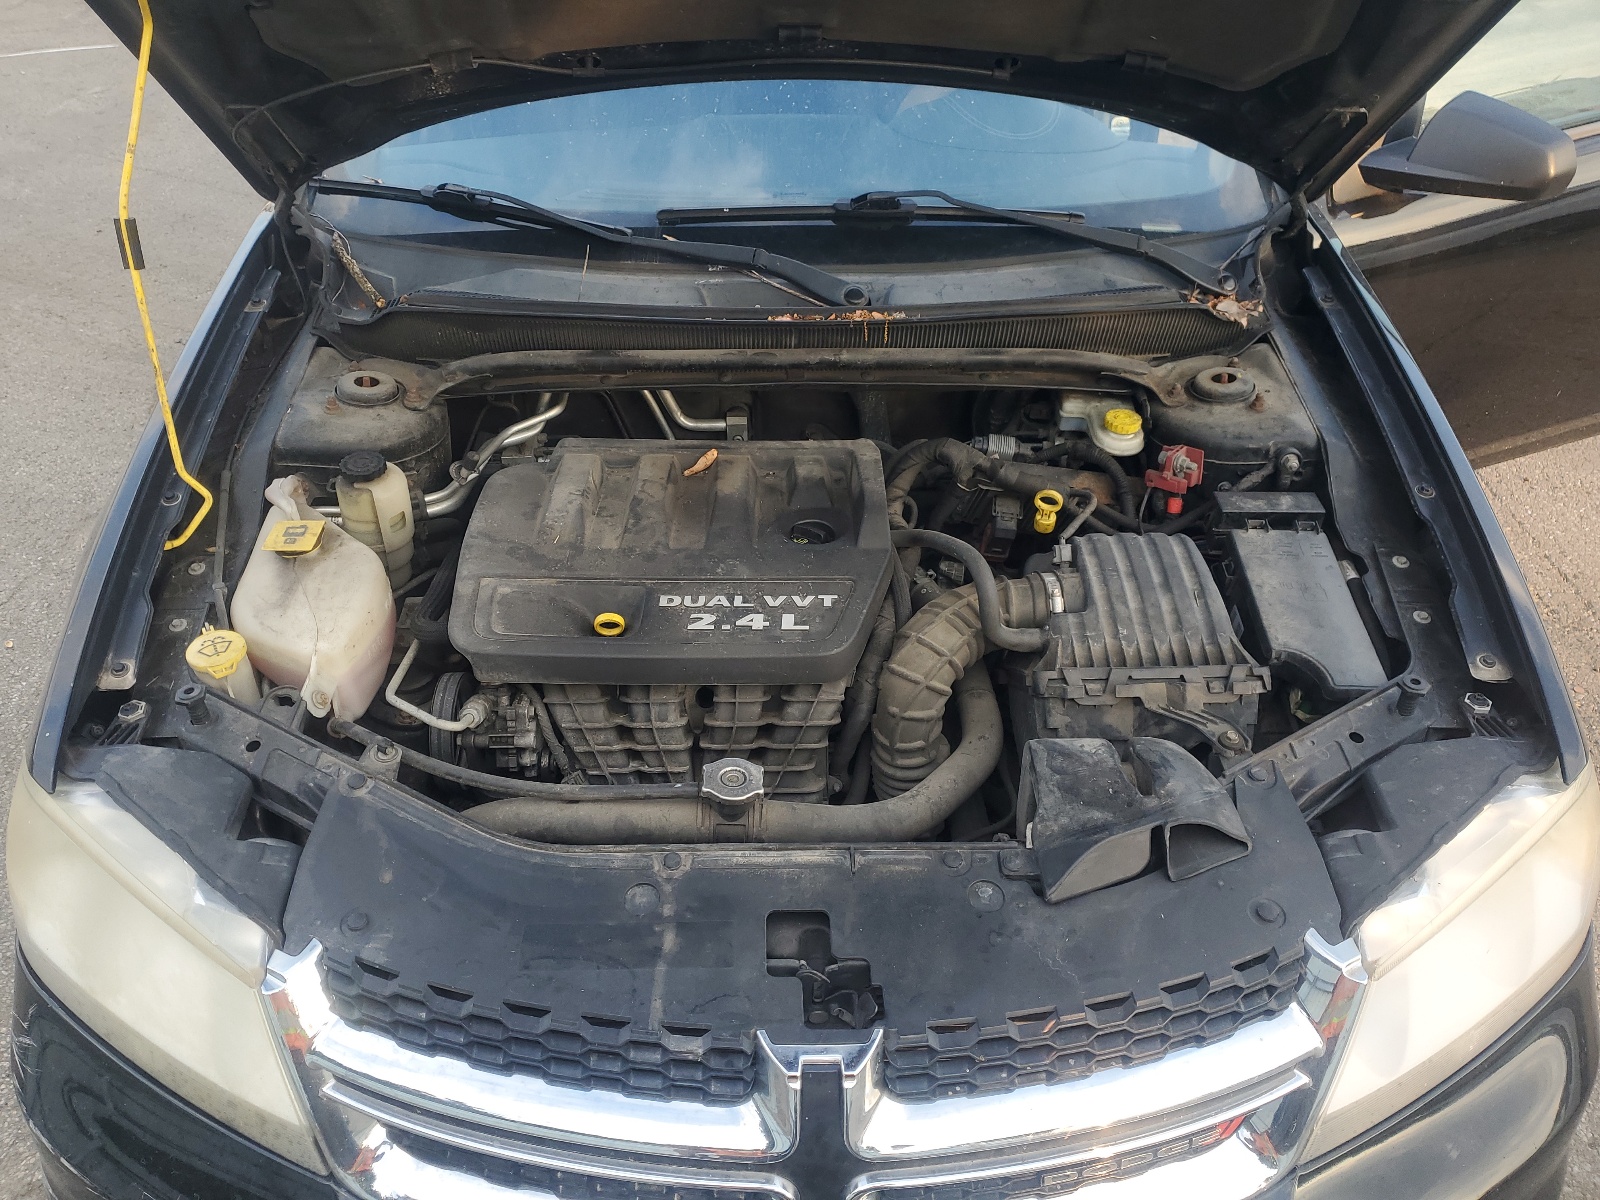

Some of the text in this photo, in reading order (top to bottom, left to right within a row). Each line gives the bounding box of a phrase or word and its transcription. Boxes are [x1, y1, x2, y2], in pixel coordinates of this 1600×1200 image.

[659, 595, 838, 607] DUAL VVT
[1042, 1128, 1222, 1186] DODGE
